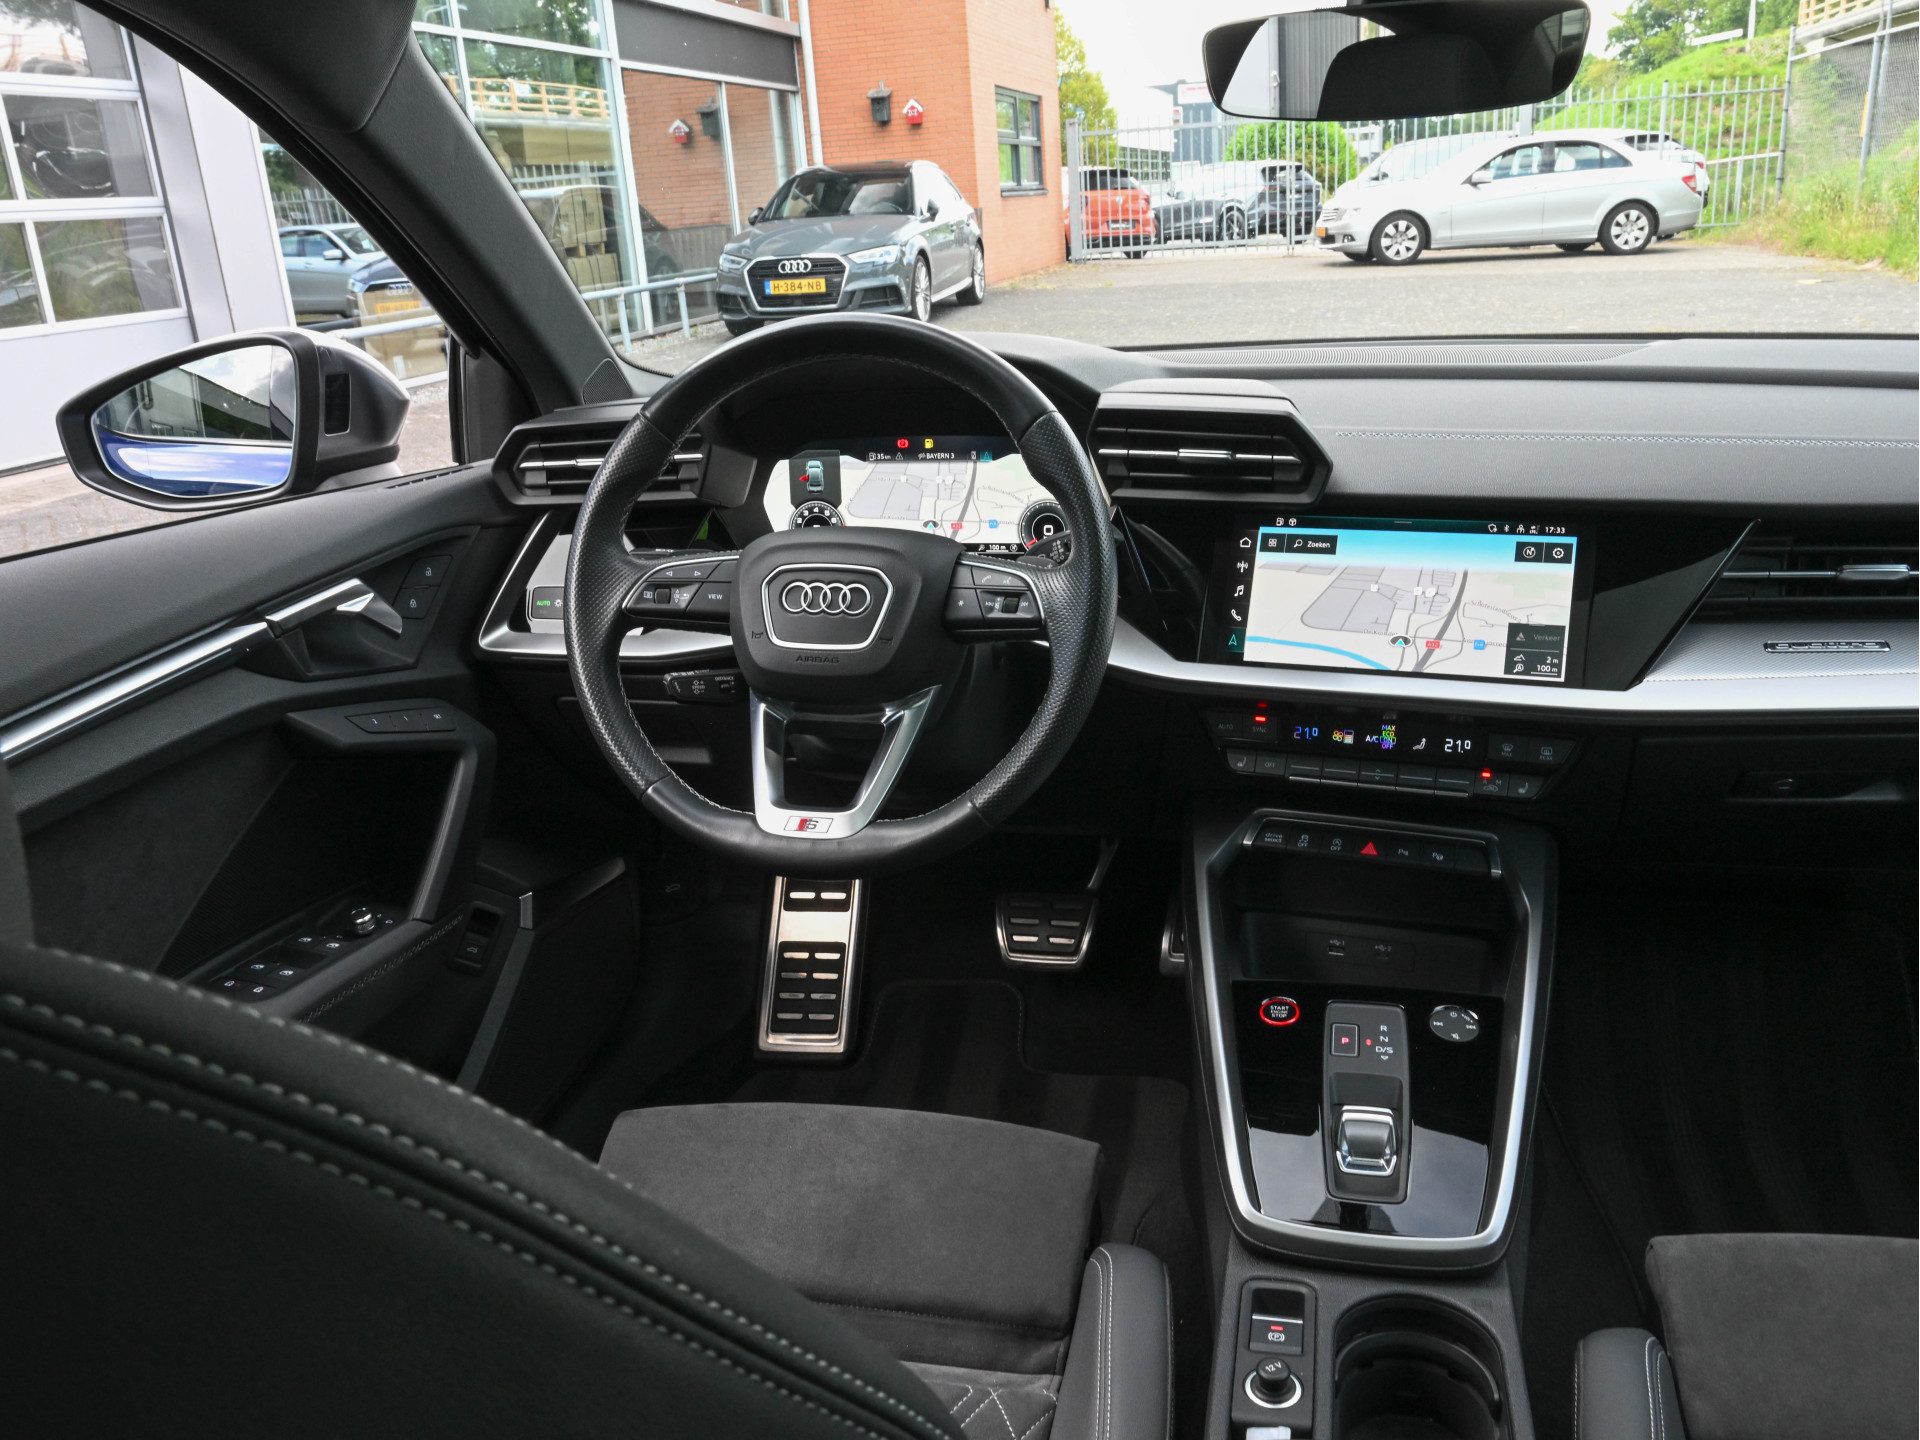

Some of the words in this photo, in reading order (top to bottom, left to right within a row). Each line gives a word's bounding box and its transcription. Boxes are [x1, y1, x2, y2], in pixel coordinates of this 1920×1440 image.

[773, 281, 822, 292] H-384-NB
[1545, 526, 1566, 534] 17:33
[795, 655, 840, 664] AIRBAG
[1546, 656, 1551, 664] 2
[1536, 664, 1551, 672] 100
[1381, 724, 1396, 732] MAX
[1365, 735, 1379, 743] A/C
[1375, 1045, 1394, 1053] D/S
[1265, 1364, 1276, 1372] 12
[1274, 1361, 1282, 1369] V
